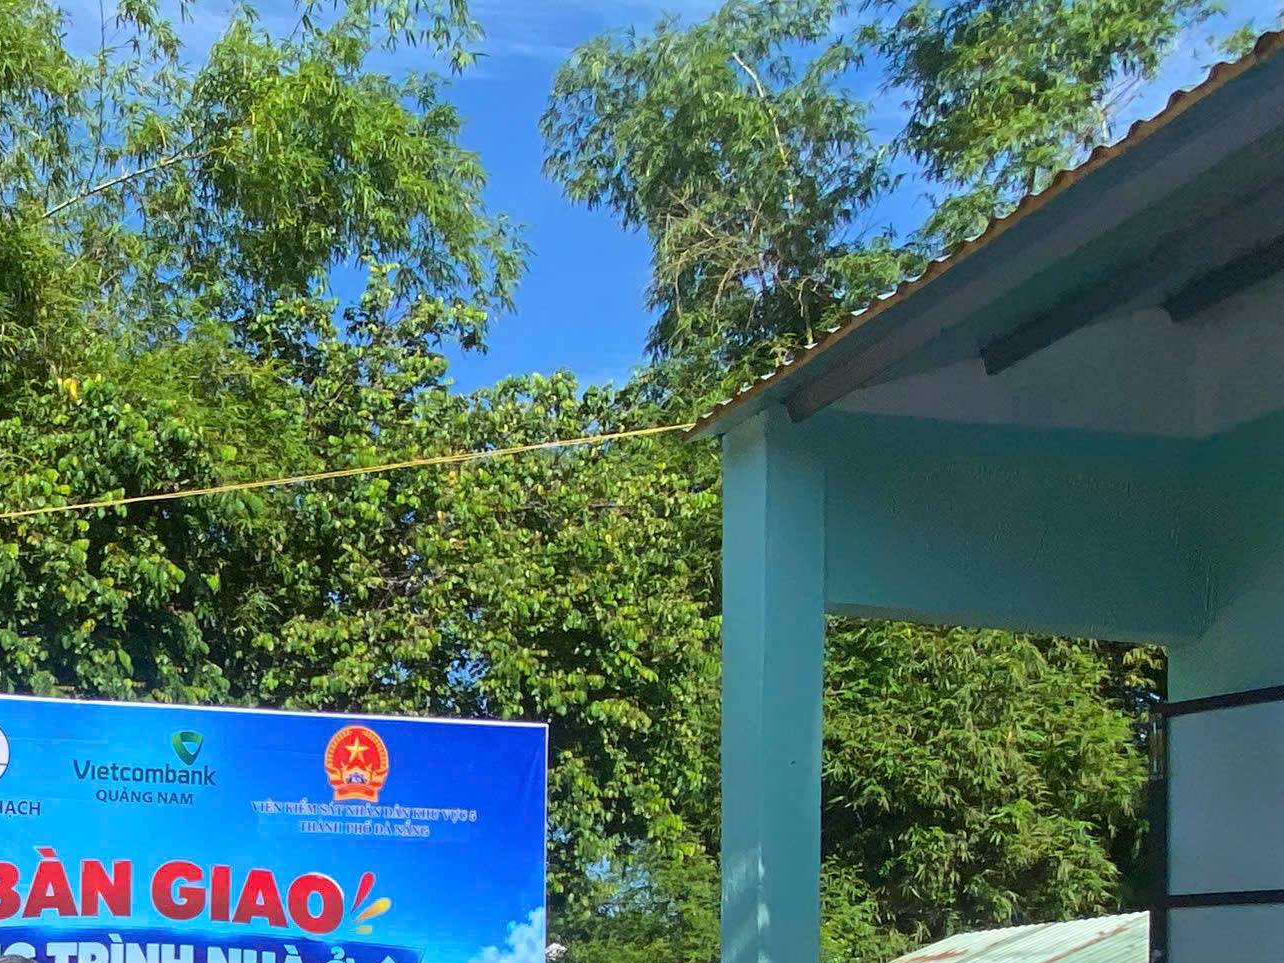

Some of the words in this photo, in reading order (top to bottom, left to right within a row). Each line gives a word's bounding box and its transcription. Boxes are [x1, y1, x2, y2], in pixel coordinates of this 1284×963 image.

[72, 759, 216, 786] Vietcombank
[96, 786, 152, 804] QUẢNG
[157, 792, 193, 805] NAM
[300, 819, 341, 834] THÀNH
[346, 818, 372, 835] PHỐ
[151, 860, 345, 935] GIAO
